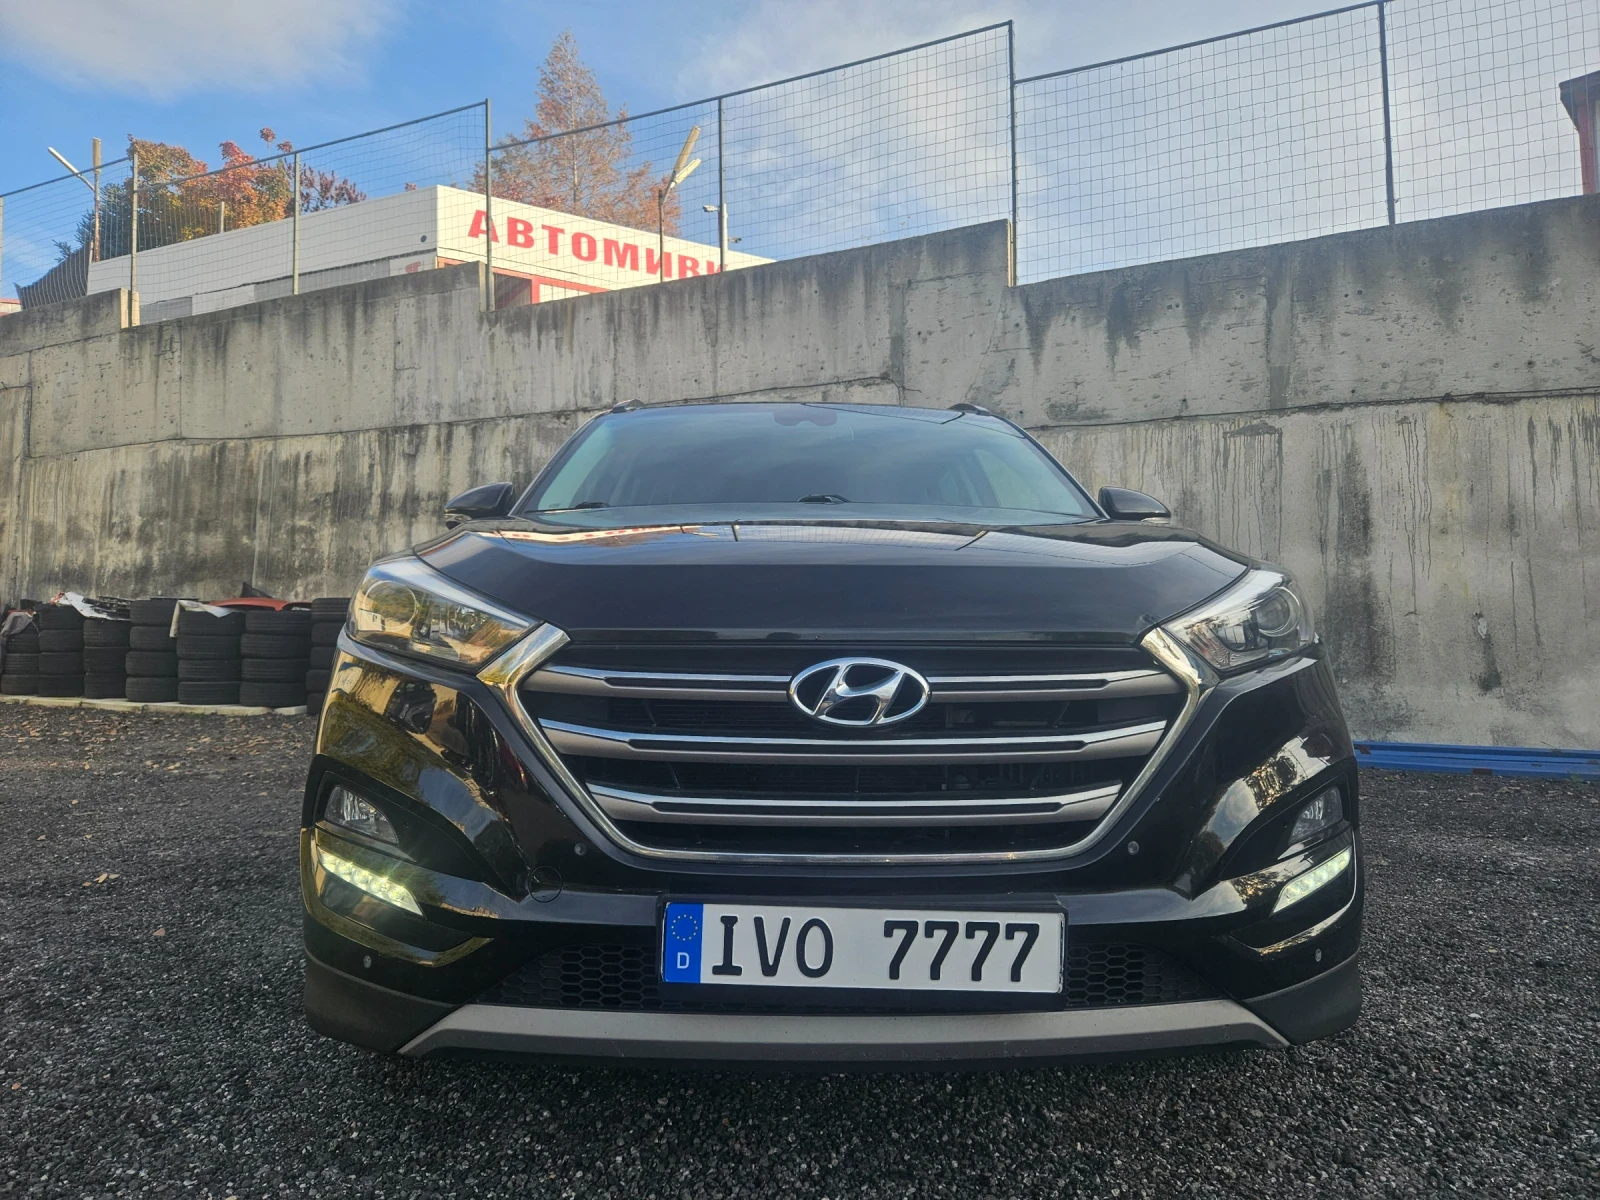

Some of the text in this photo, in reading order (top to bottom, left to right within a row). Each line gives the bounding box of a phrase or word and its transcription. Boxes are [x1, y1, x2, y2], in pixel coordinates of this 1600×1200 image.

[676, 951, 690, 969] D
[711, 915, 1040, 982] IVO 7777
